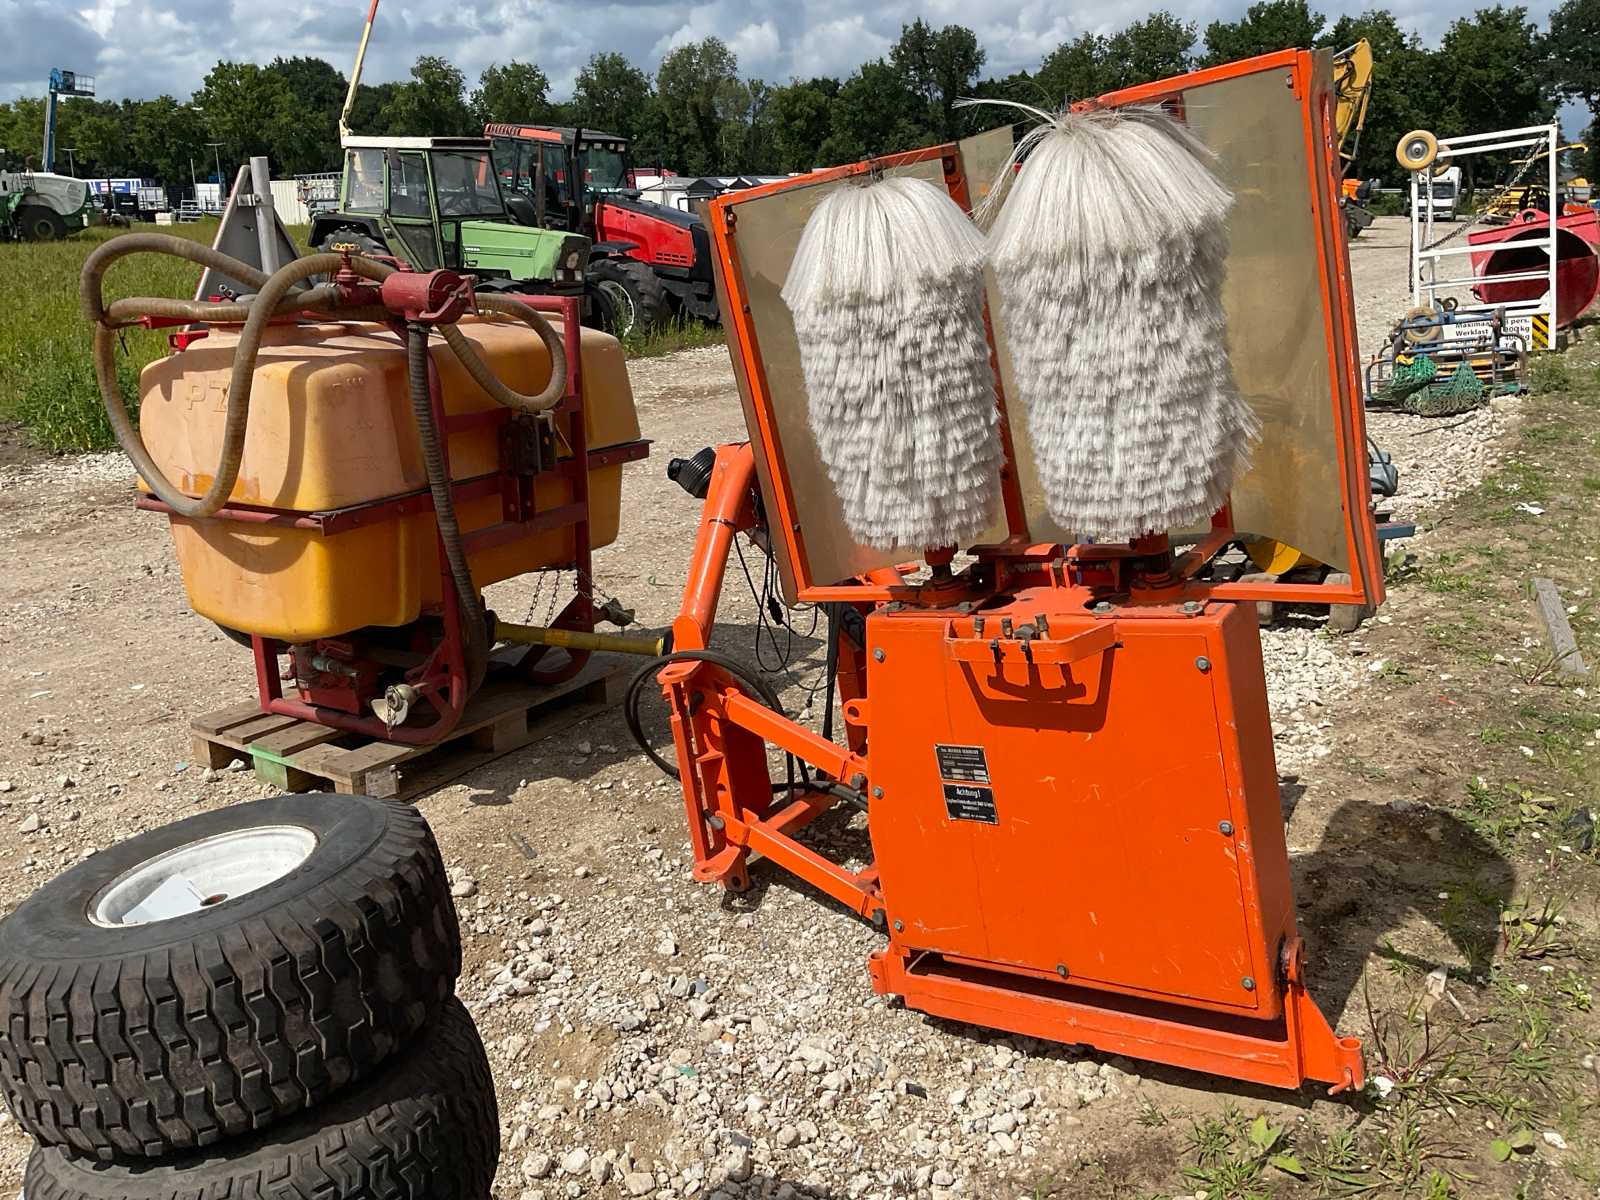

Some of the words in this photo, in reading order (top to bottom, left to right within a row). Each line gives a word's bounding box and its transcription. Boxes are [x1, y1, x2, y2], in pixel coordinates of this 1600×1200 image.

[1456, 320, 1493, 328] Maximaa
[1456, 329, 1489, 337] Werklast
[1520, 325, 1530, 333] kg
[957, 788, 981, 799] Achtung!
